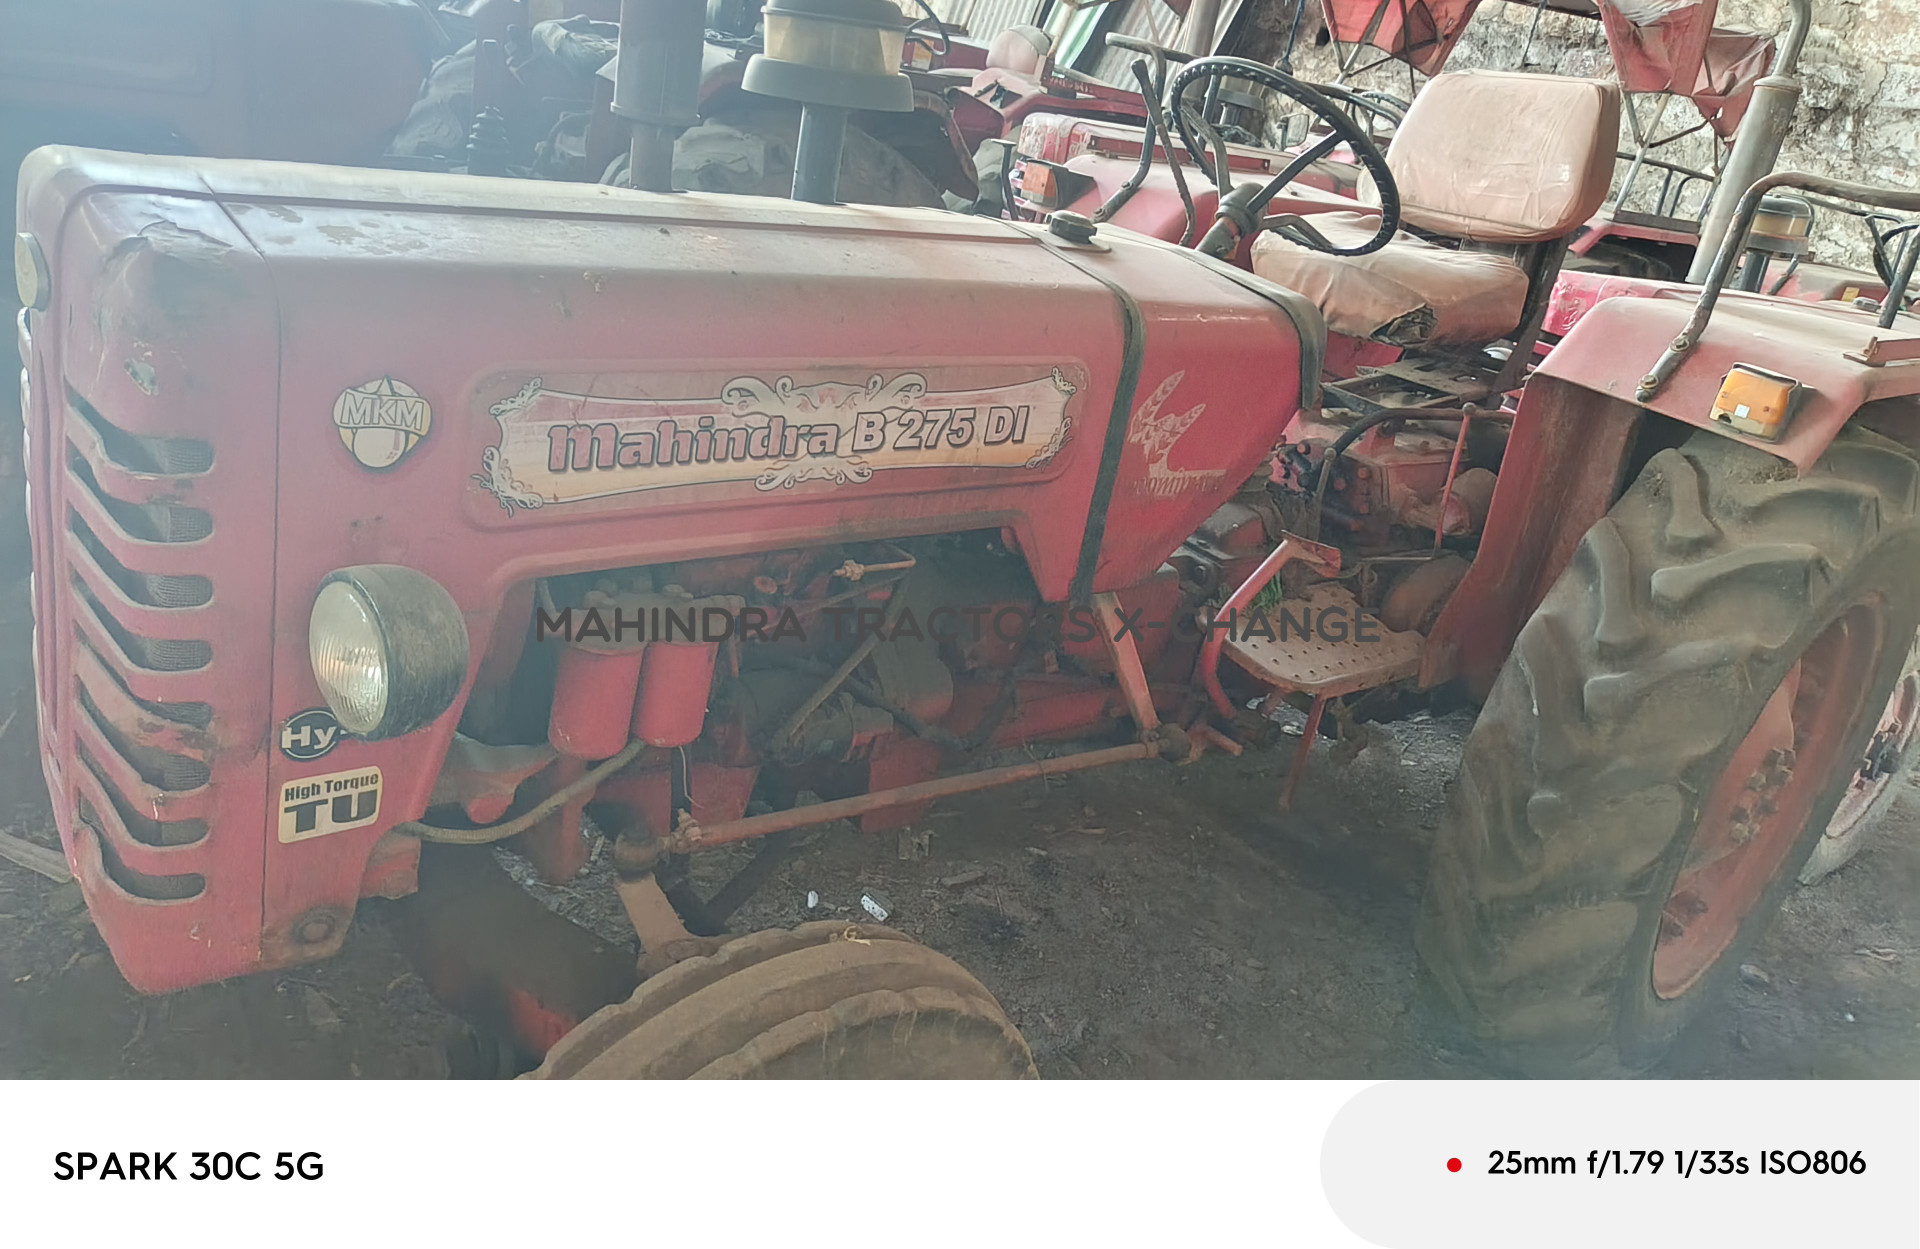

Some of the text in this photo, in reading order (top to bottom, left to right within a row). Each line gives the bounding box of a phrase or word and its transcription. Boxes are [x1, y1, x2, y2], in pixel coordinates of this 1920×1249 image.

[340, 391, 425, 432] MKM
[548, 405, 1030, 472] Mahindra B 275 DI
[284, 773, 379, 802] High Torque
[283, 789, 378, 834] TU
